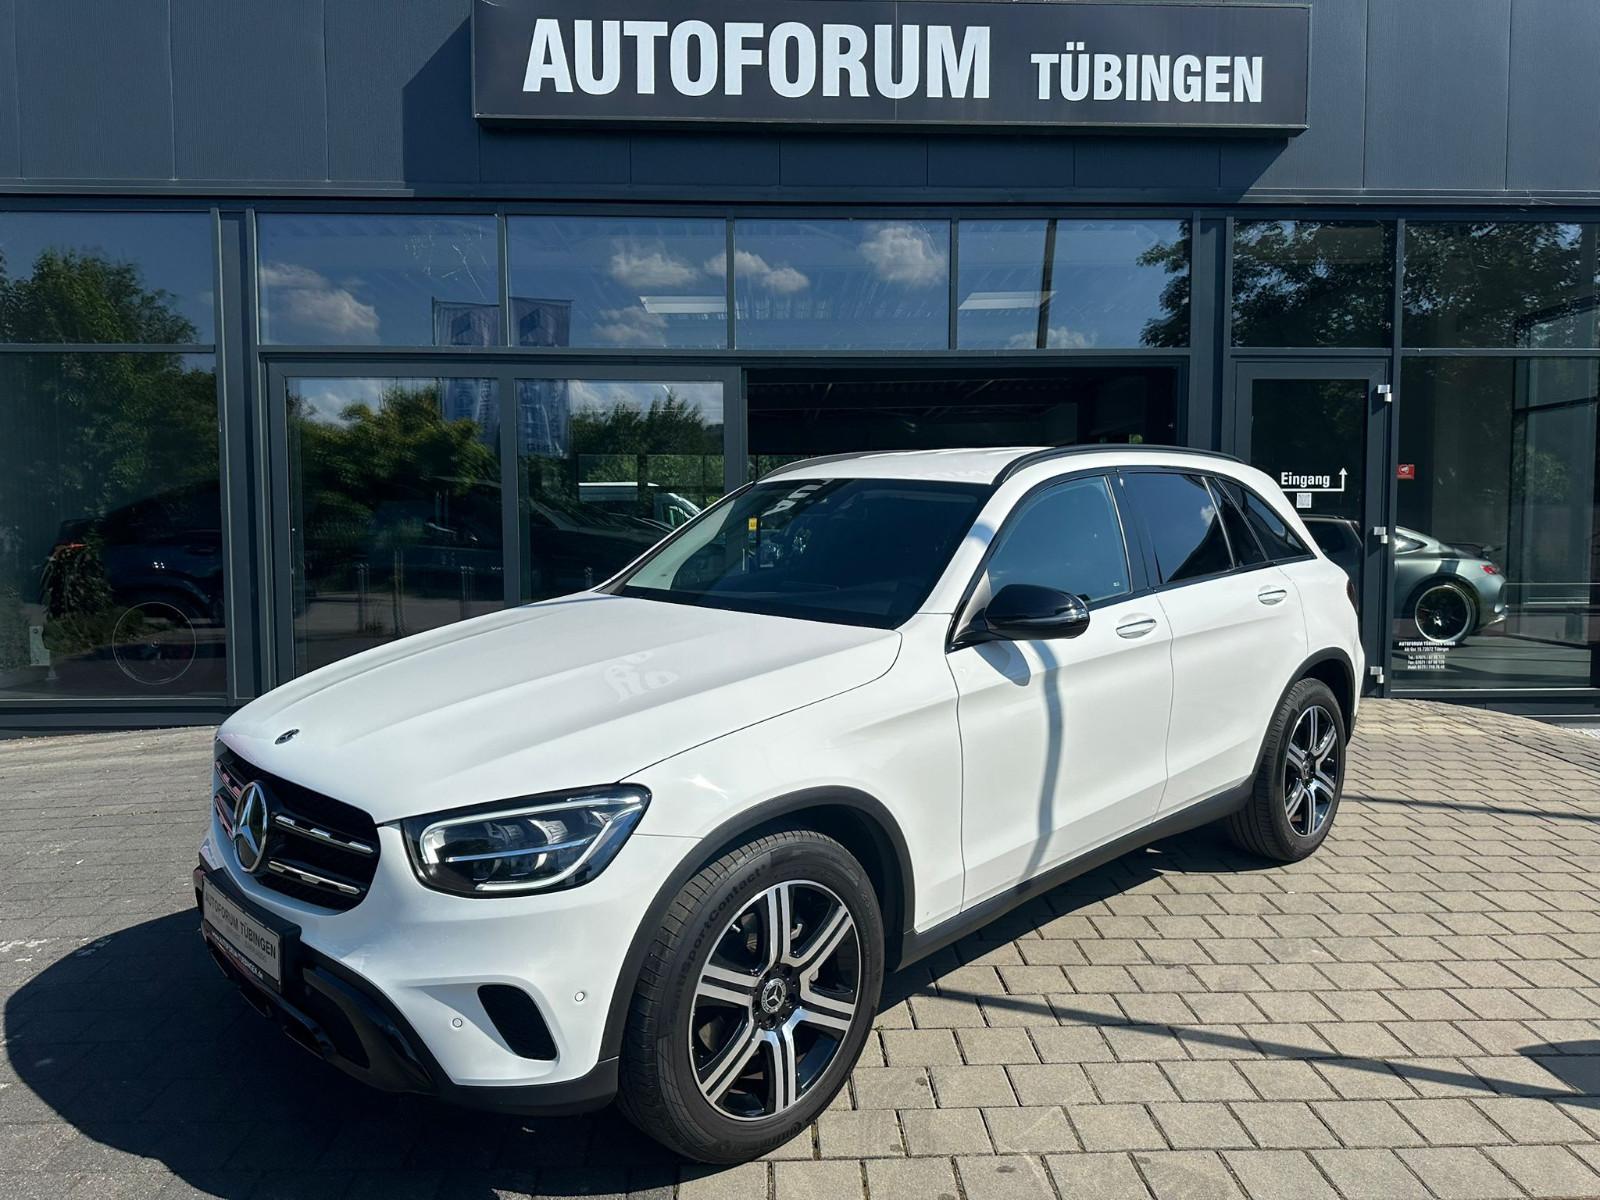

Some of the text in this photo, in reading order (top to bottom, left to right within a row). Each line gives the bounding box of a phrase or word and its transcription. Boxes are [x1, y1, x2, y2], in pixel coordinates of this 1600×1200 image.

[522, 18, 1264, 104] AUTOFORUM TÜBINGEN
[1281, 472, 1330, 488] Eingang
[240, 922, 276, 959] TÜBINGEN
